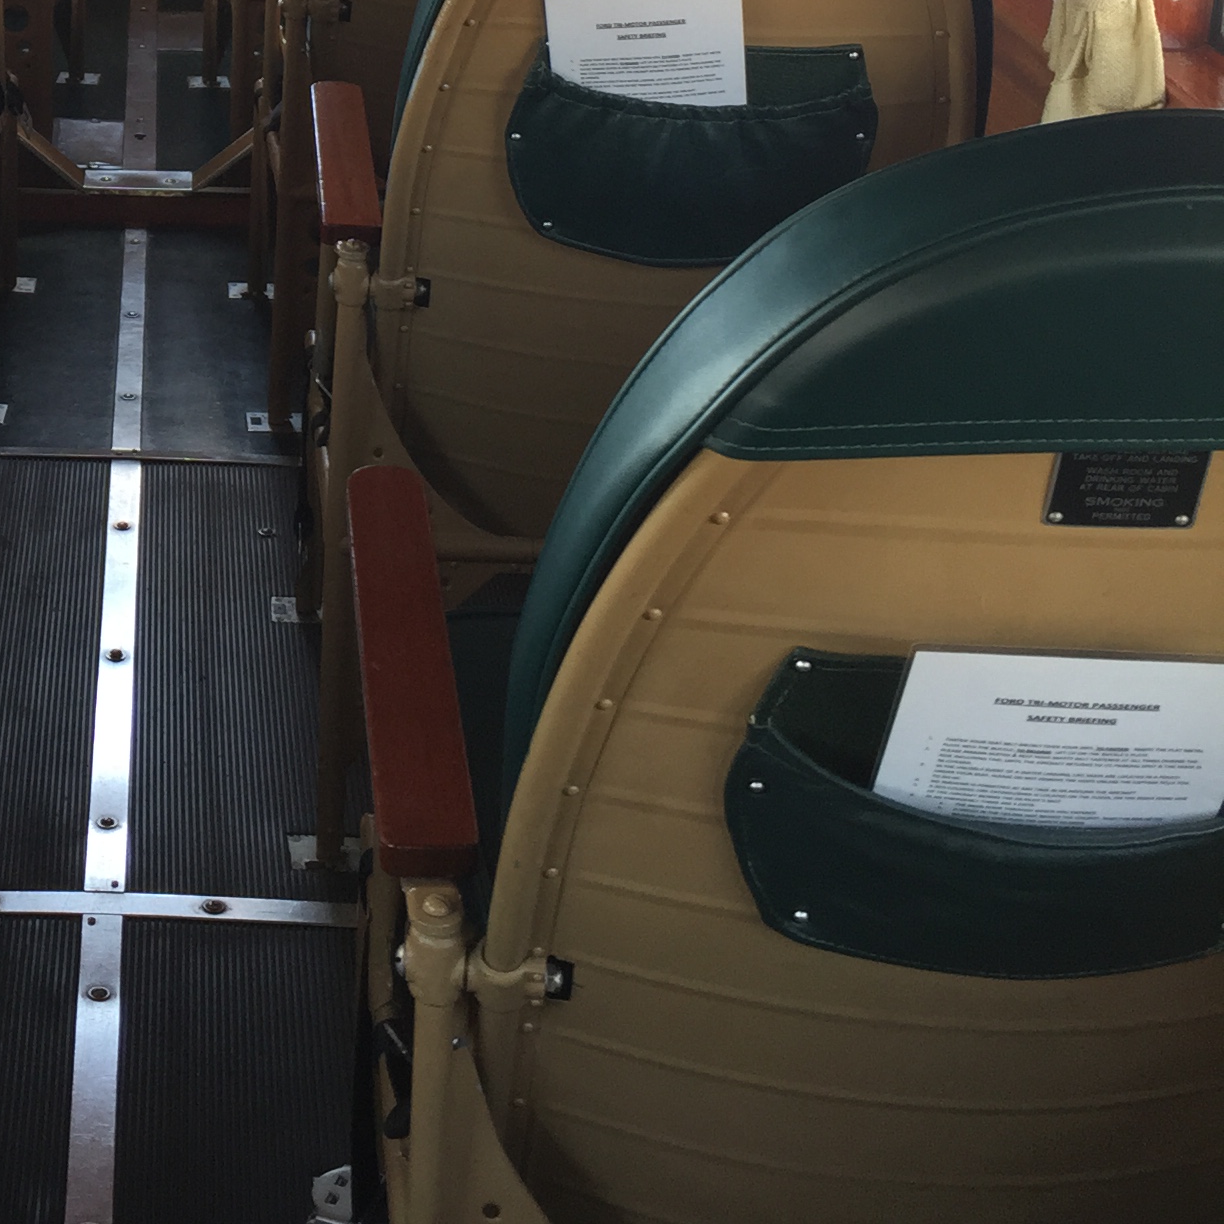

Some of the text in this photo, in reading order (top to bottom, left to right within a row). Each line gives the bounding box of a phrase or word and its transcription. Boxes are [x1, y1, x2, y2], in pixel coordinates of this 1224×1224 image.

[1126, 455, 1150, 463] AND
[1157, 468, 1179, 476] AND
[1085, 497, 1164, 508] SMOKING
[1092, 511, 1152, 521] PERMITTED
[994, 697, 1024, 705] FORD
[1028, 699, 1089, 709] TRI-MOTOR
[1068, 717, 1117, 726] BRIEFING
